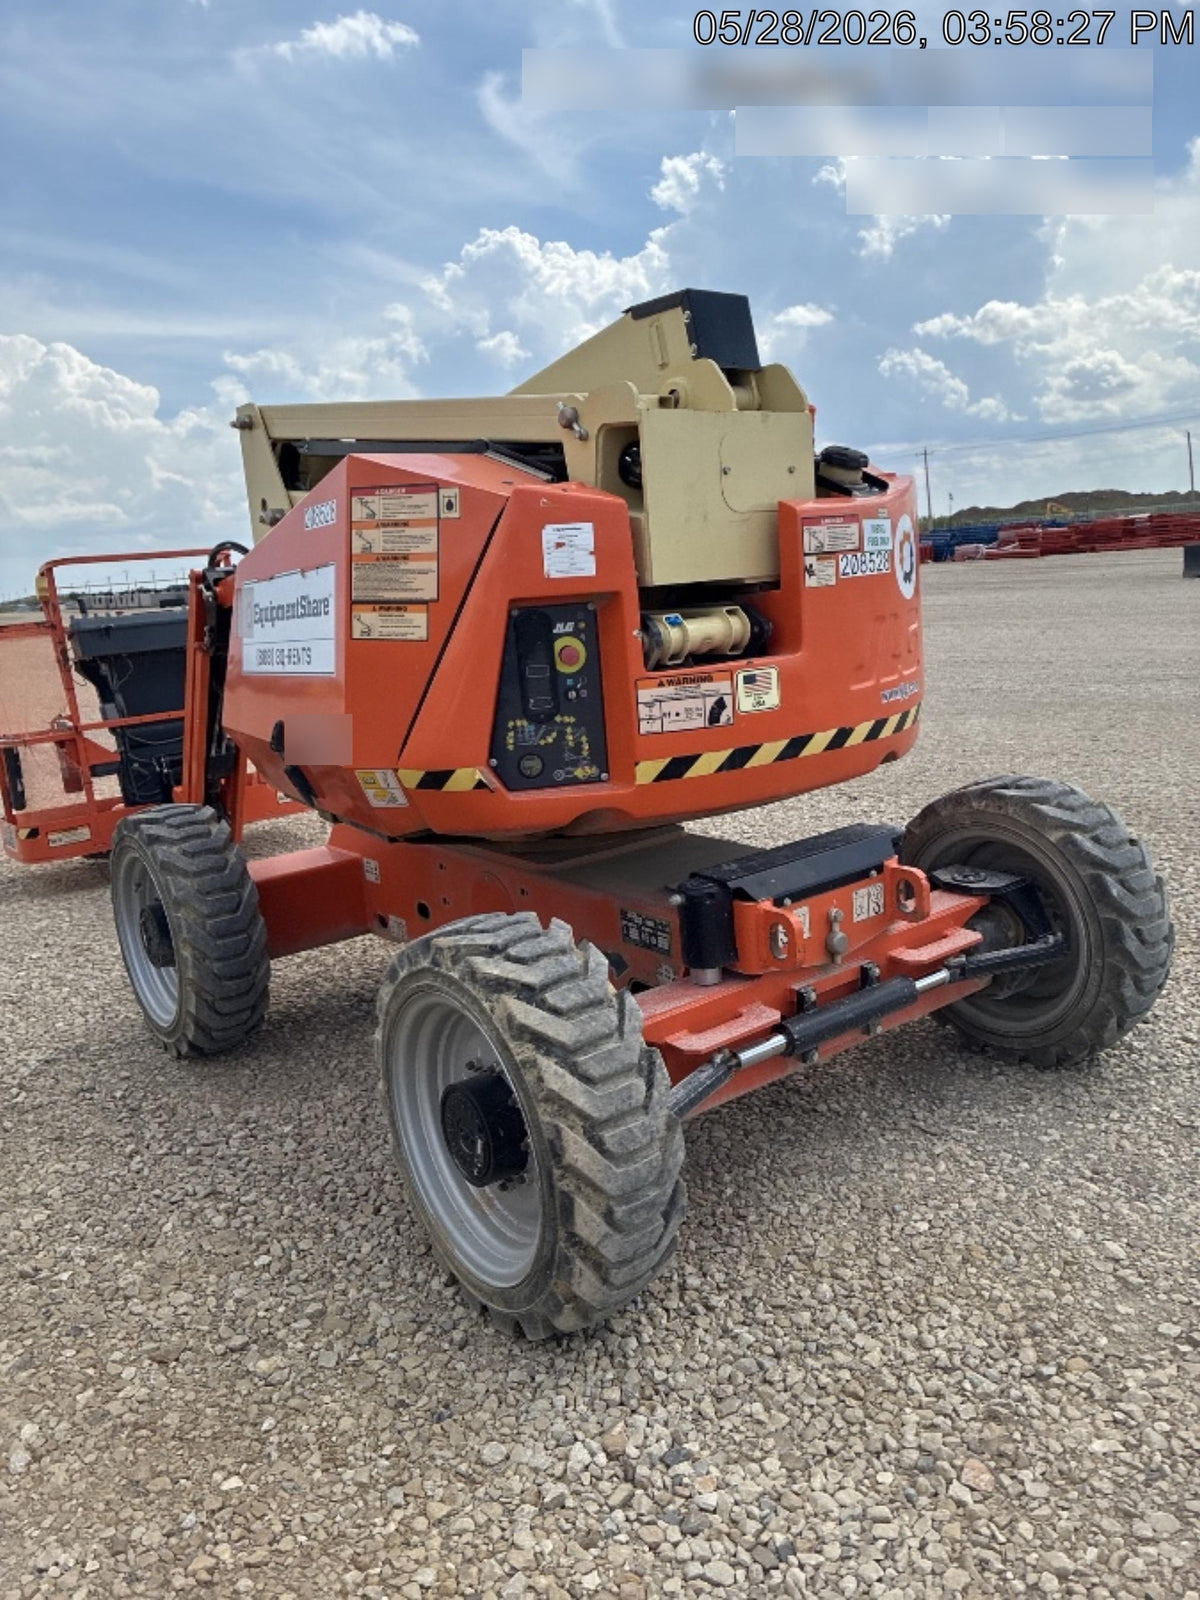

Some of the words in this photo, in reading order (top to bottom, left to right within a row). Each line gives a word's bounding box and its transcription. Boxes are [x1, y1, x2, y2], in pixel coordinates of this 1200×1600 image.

[840, 550, 890, 577] 208528
[253, 594, 330, 629] EquipmentShare
[667, 674, 714, 687] WARNING
